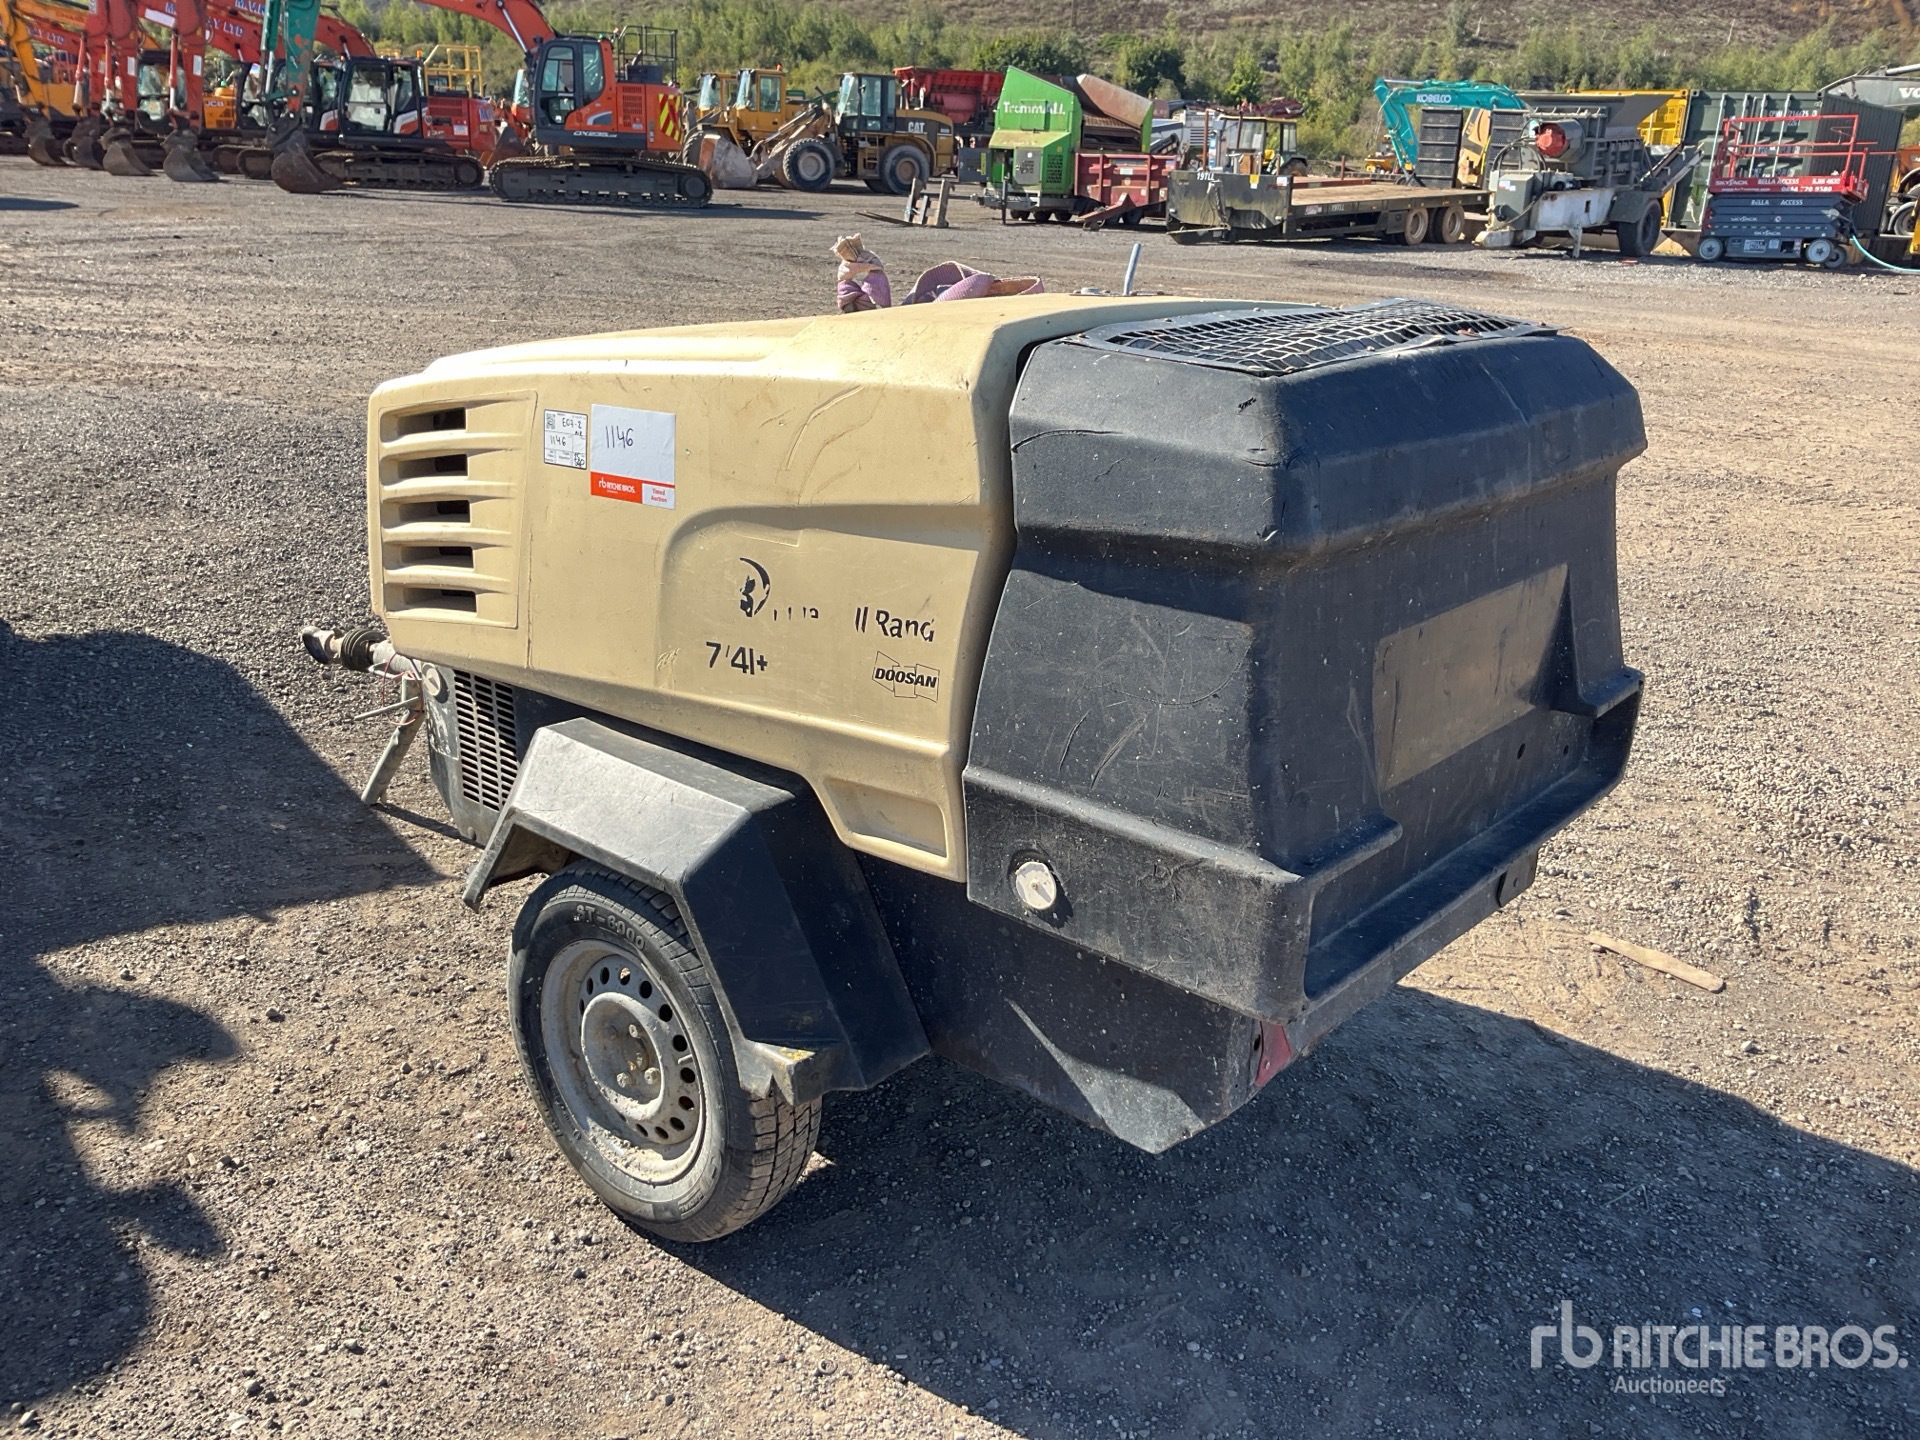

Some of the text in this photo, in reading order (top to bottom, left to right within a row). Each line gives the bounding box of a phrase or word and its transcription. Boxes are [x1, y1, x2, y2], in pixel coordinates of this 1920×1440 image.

[204, 99, 225, 108] JCB
[1416, 93, 1452, 104] KOBELCO
[908, 121, 926, 134] CAT
[1196, 172, 1216, 181] 19TLL
[550, 434, 566, 447] 1146
[605, 425, 634, 449] 1146
[652, 488, 666, 496] Timed
[651, 495, 668, 503] Auction
[874, 667, 938, 689] DOOSAN
[575, 904, 646, 950] ST-6000
